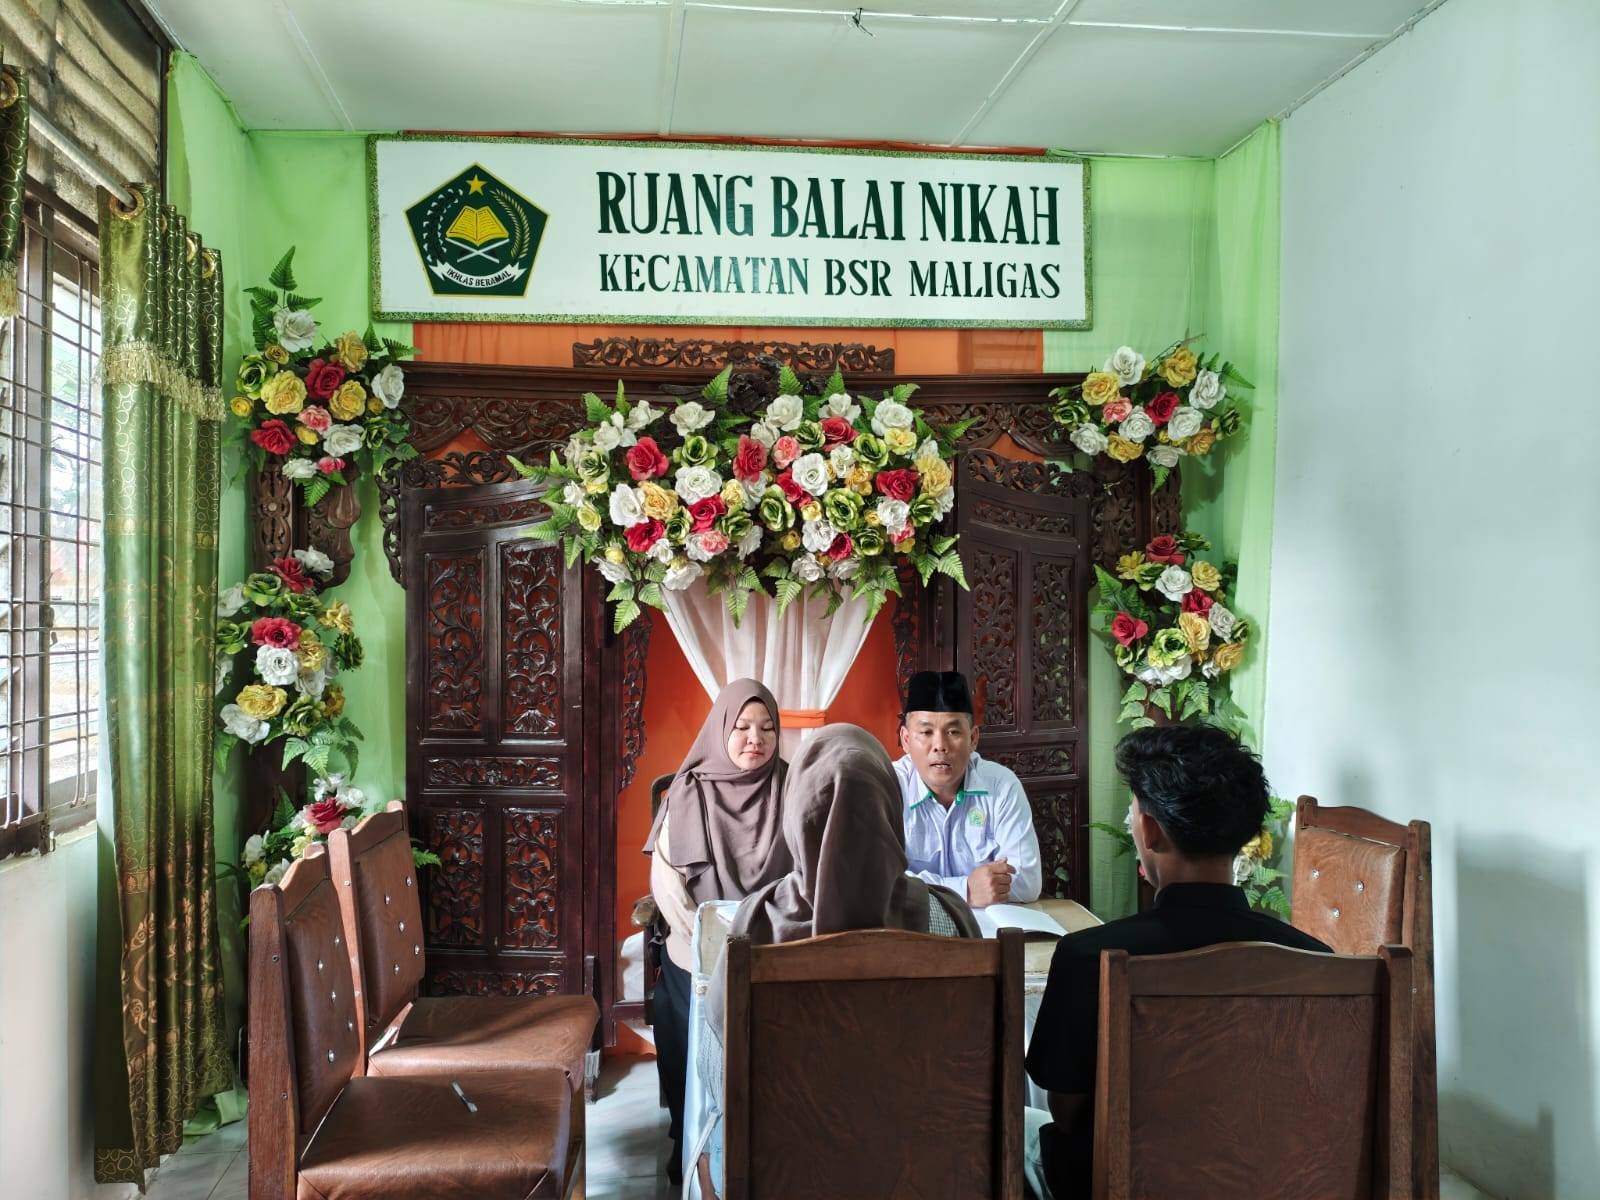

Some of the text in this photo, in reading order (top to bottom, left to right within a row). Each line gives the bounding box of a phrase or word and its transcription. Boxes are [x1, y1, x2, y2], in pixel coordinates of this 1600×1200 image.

[596, 171, 1061, 246] RUANG BALAI NIKAH
[446, 268, 512, 287] IKHLAS BERAMAL
[599, 253, 1061, 299] KECAMATAN BSR MALIGAS
